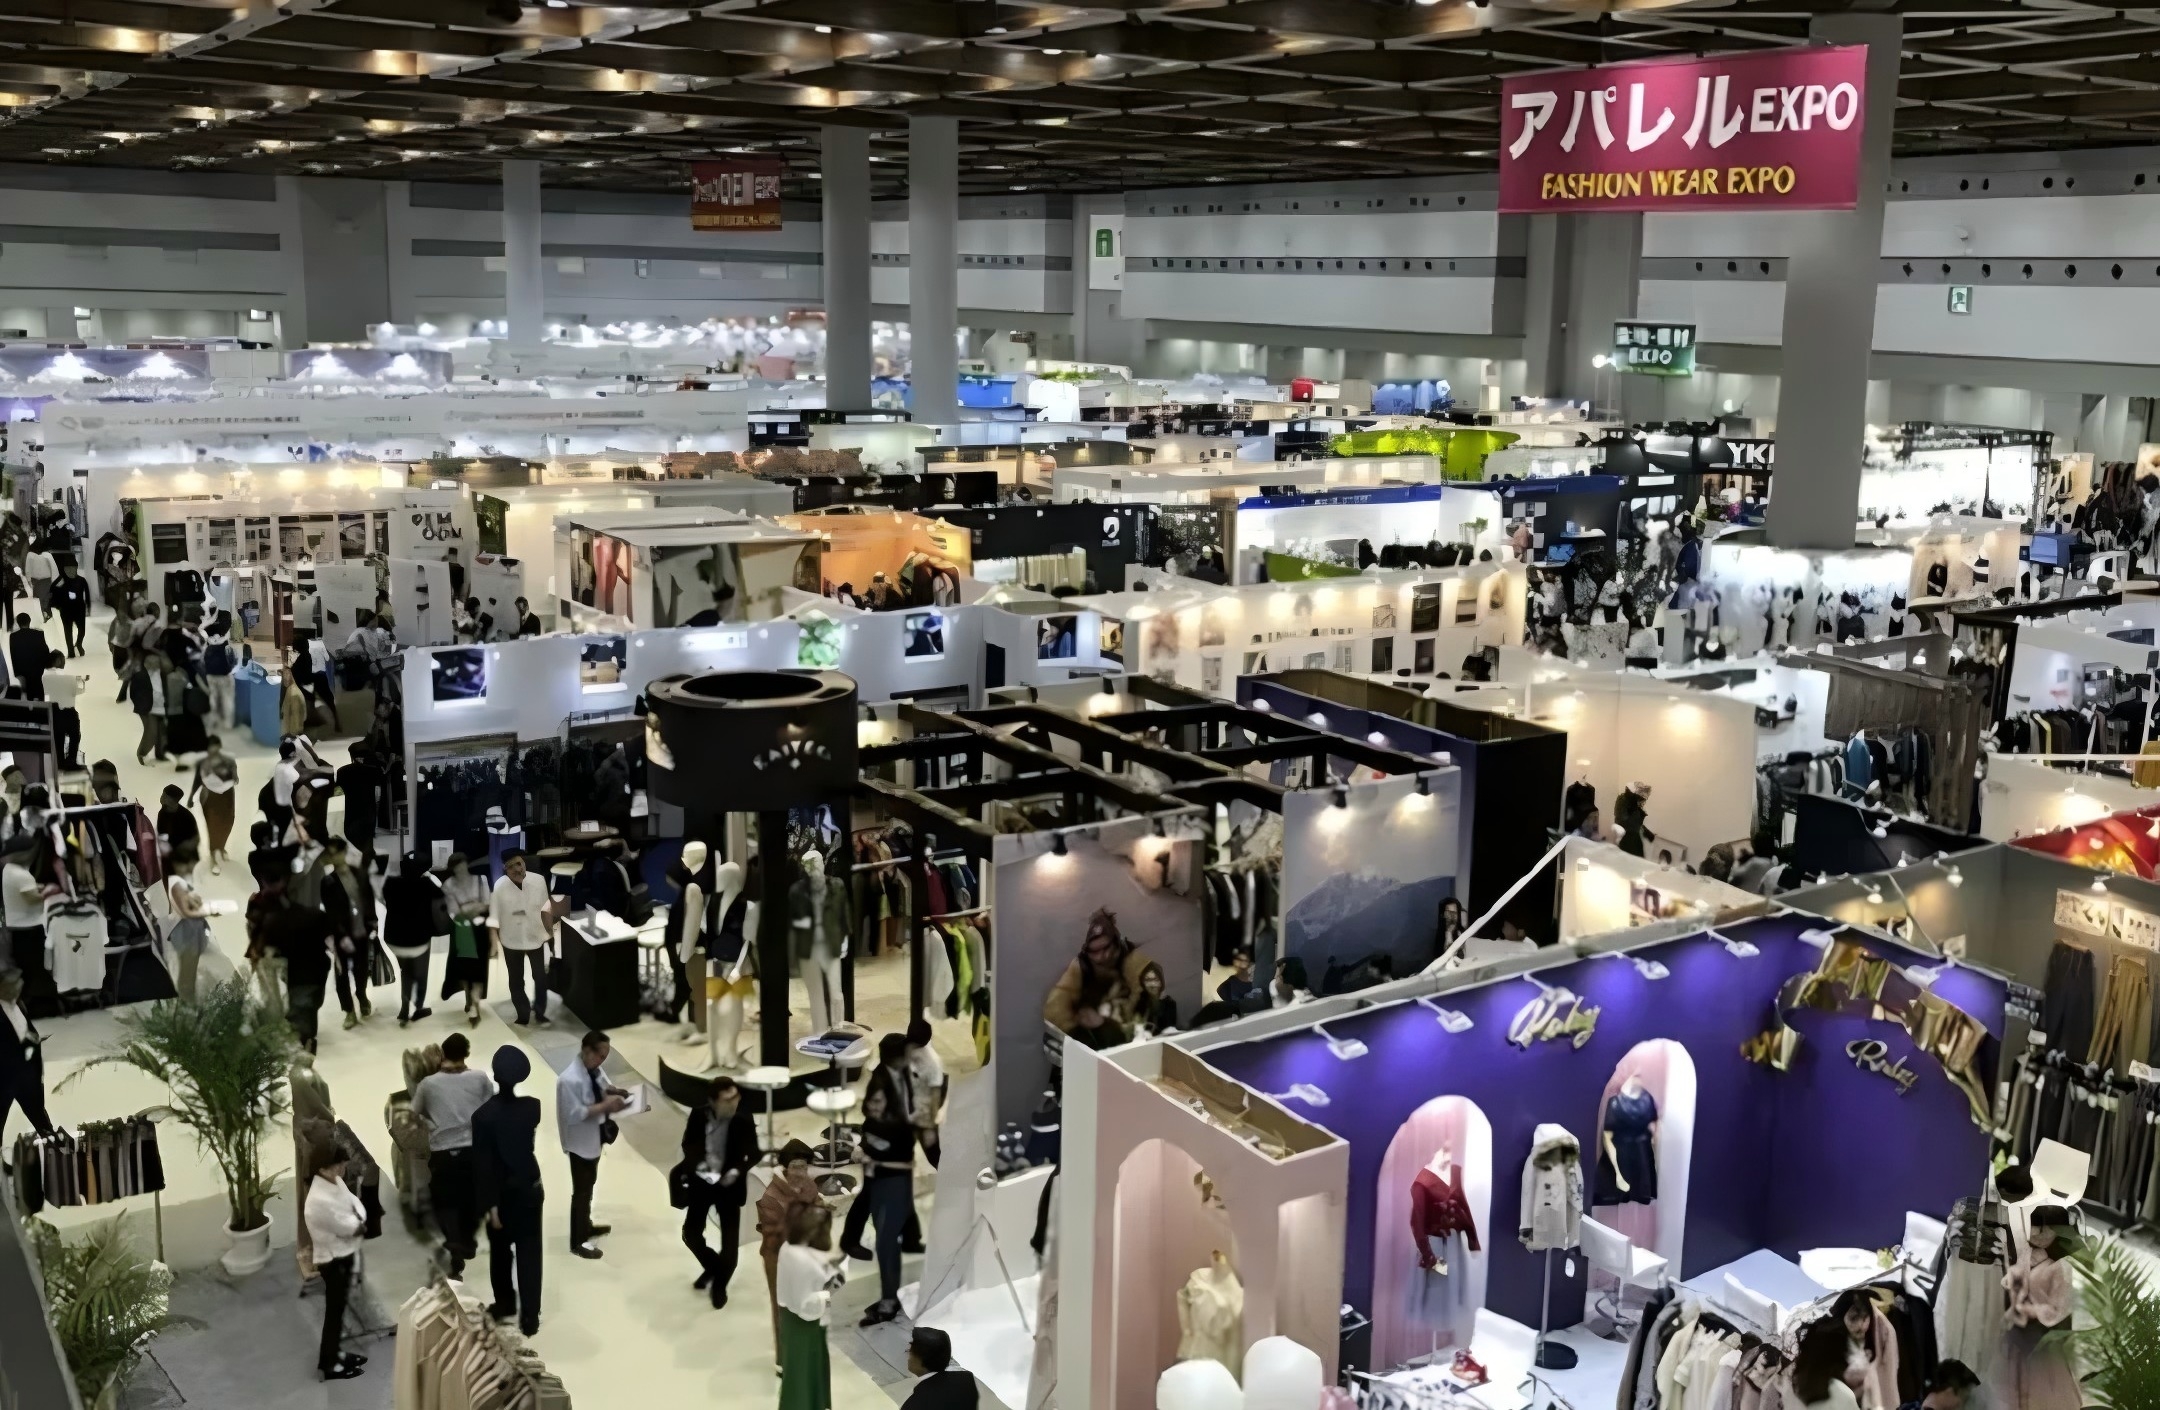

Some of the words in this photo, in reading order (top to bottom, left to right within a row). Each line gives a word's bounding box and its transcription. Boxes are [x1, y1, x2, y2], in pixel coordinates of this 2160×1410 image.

[1509, 75, 1745, 160] アパレル
[1750, 82, 1858, 133] EXPO
[1541, 171, 1643, 199] FASHION
[1649, 167, 1719, 196] WEAR
[1727, 165, 1796, 194] EXPO
